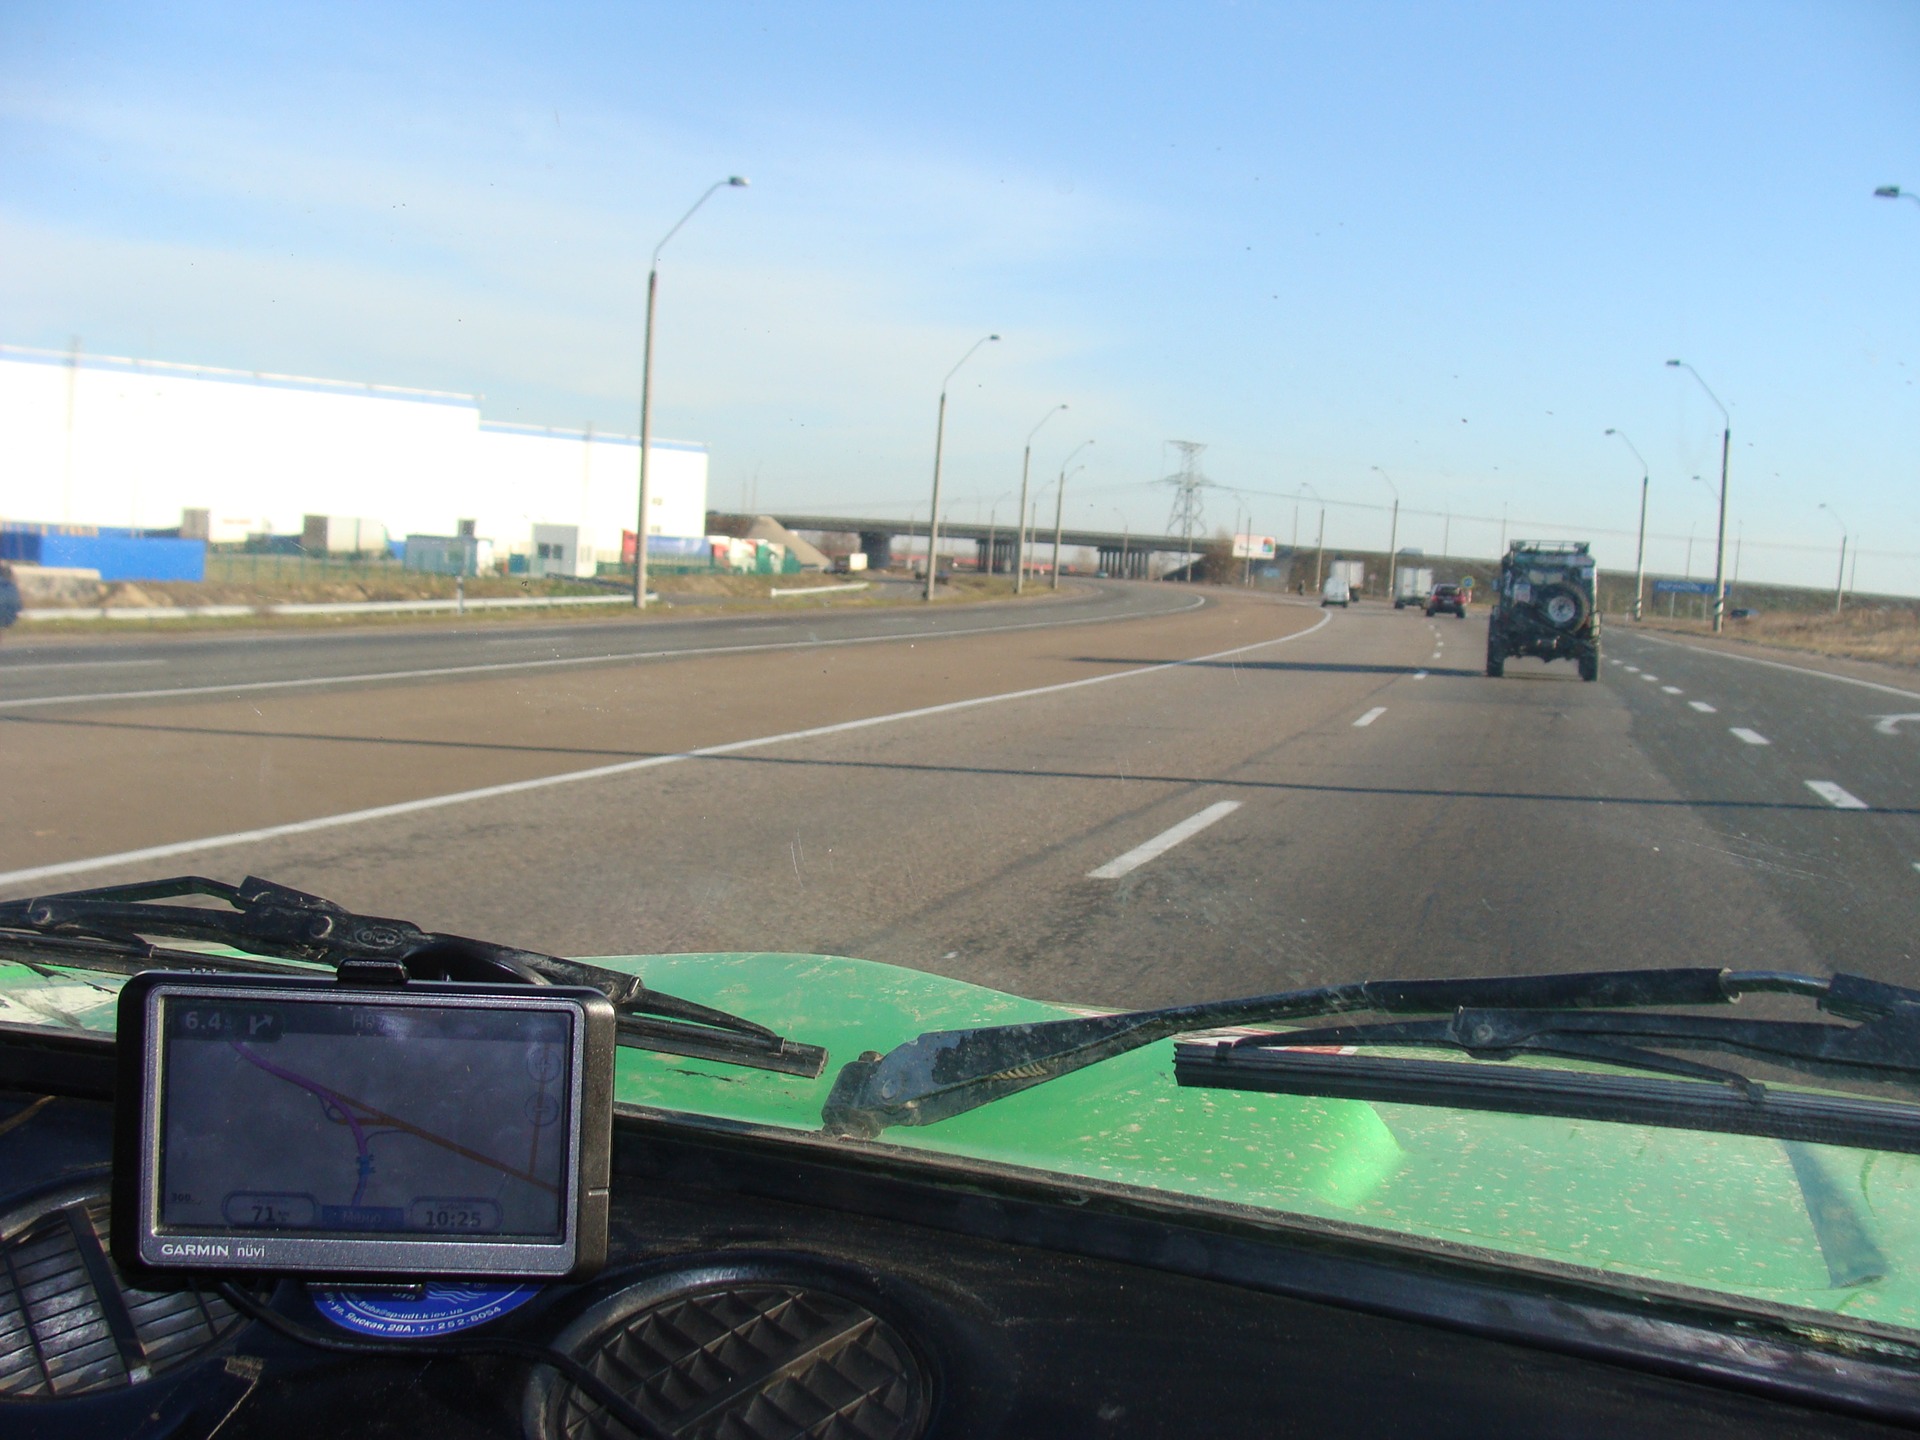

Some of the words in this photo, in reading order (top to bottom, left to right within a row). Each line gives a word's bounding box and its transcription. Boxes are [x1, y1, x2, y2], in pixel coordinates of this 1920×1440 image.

[184, 1010, 222, 1031] 6.4
[251, 1205, 276, 1222] 71
[426, 1210, 482, 1228] 10:25
[161, 1243, 229, 1256] GARMIN
[237, 1244, 265, 1257] nüvi
